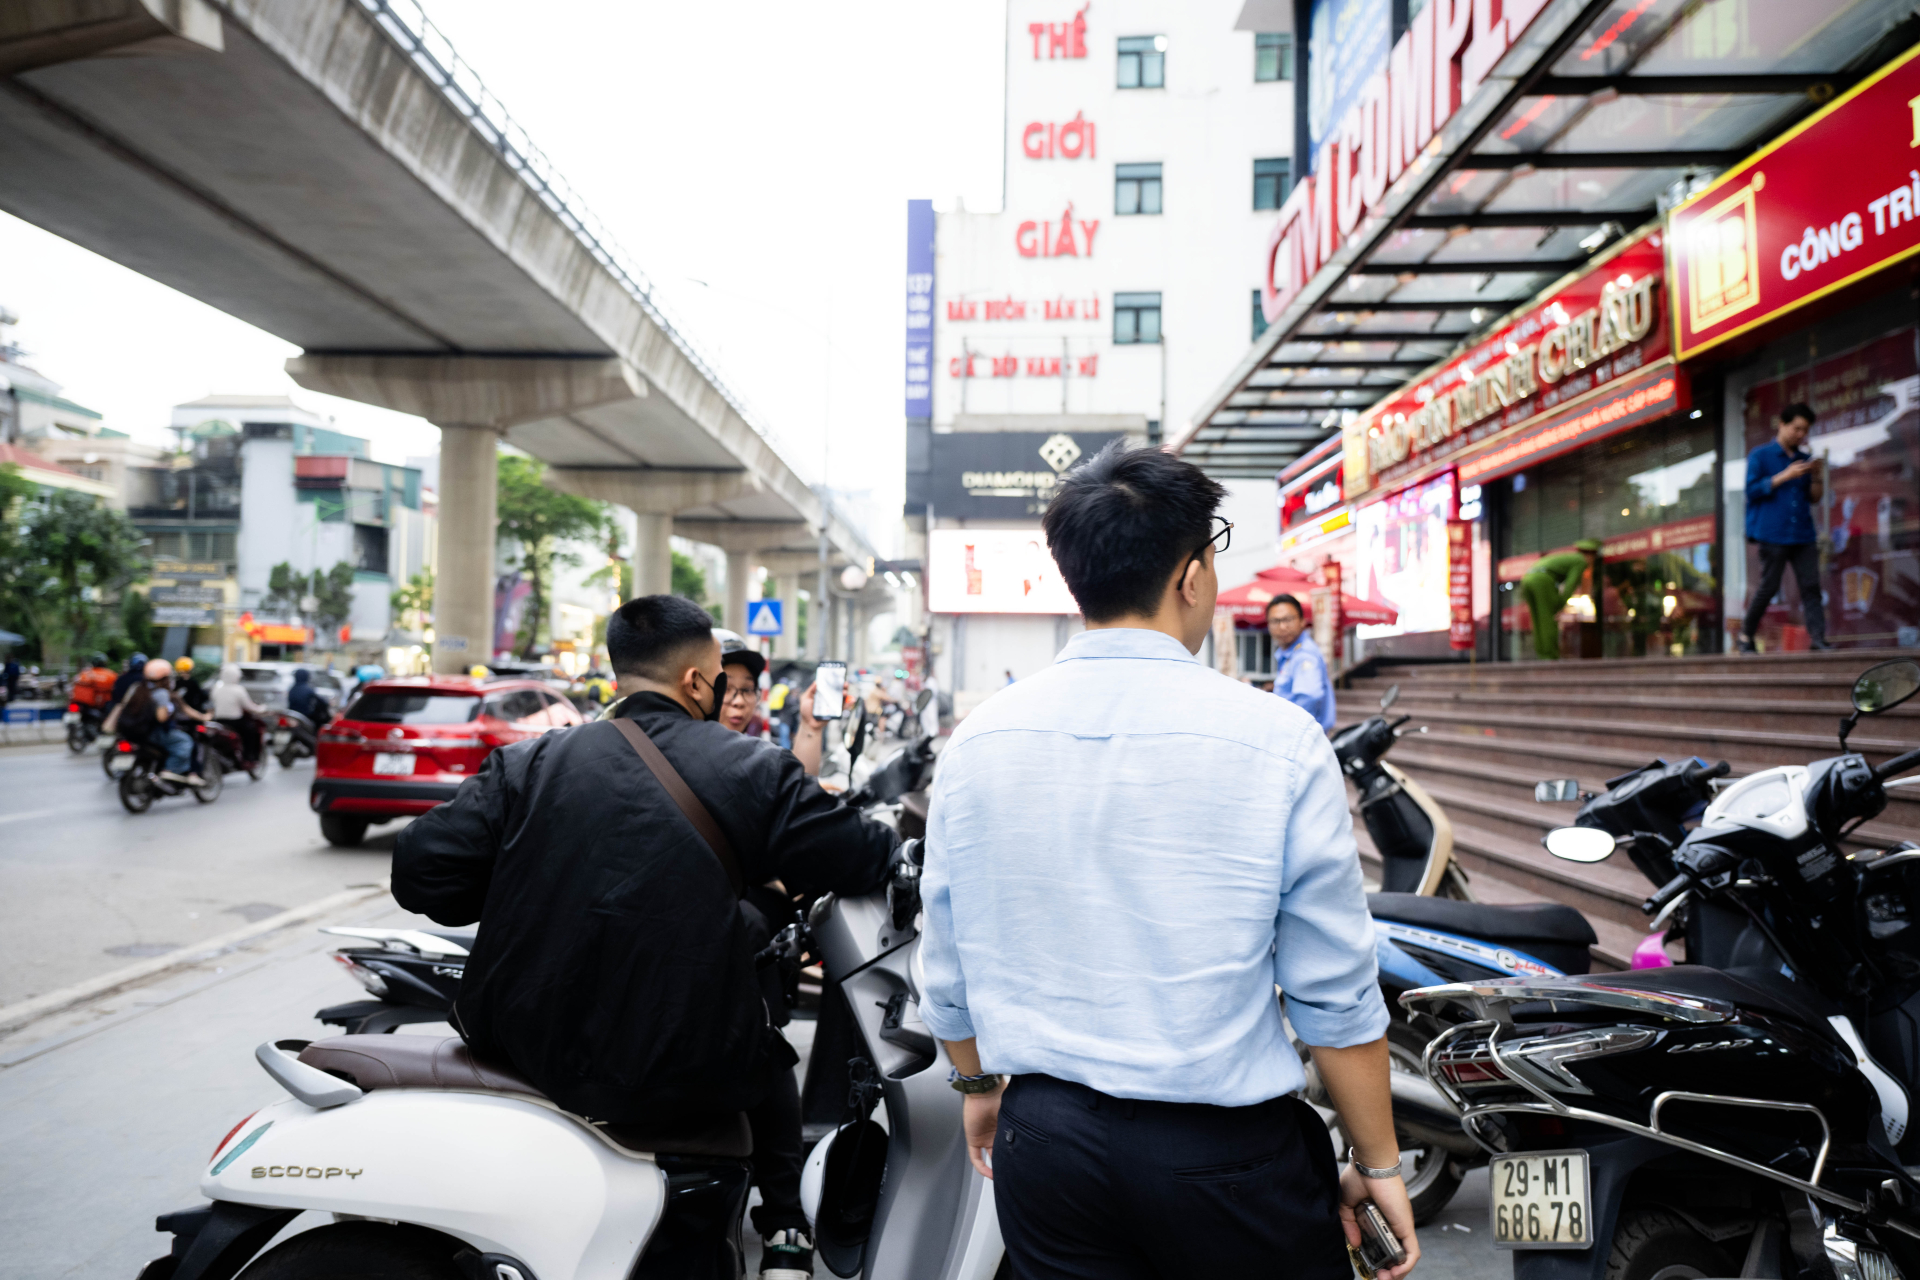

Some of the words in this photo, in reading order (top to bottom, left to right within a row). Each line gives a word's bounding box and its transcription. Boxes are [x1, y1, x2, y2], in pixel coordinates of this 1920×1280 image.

[1337, 0, 1549, 236] COMPL
[1781, 211, 1863, 280] CÔNG
[1667, 1038, 1753, 1053] LEAD
[251, 1165, 363, 1179] SCOOPY
[1504, 1158, 1570, 1197] 29-M1
[1497, 1201, 1583, 1241] 686.78
